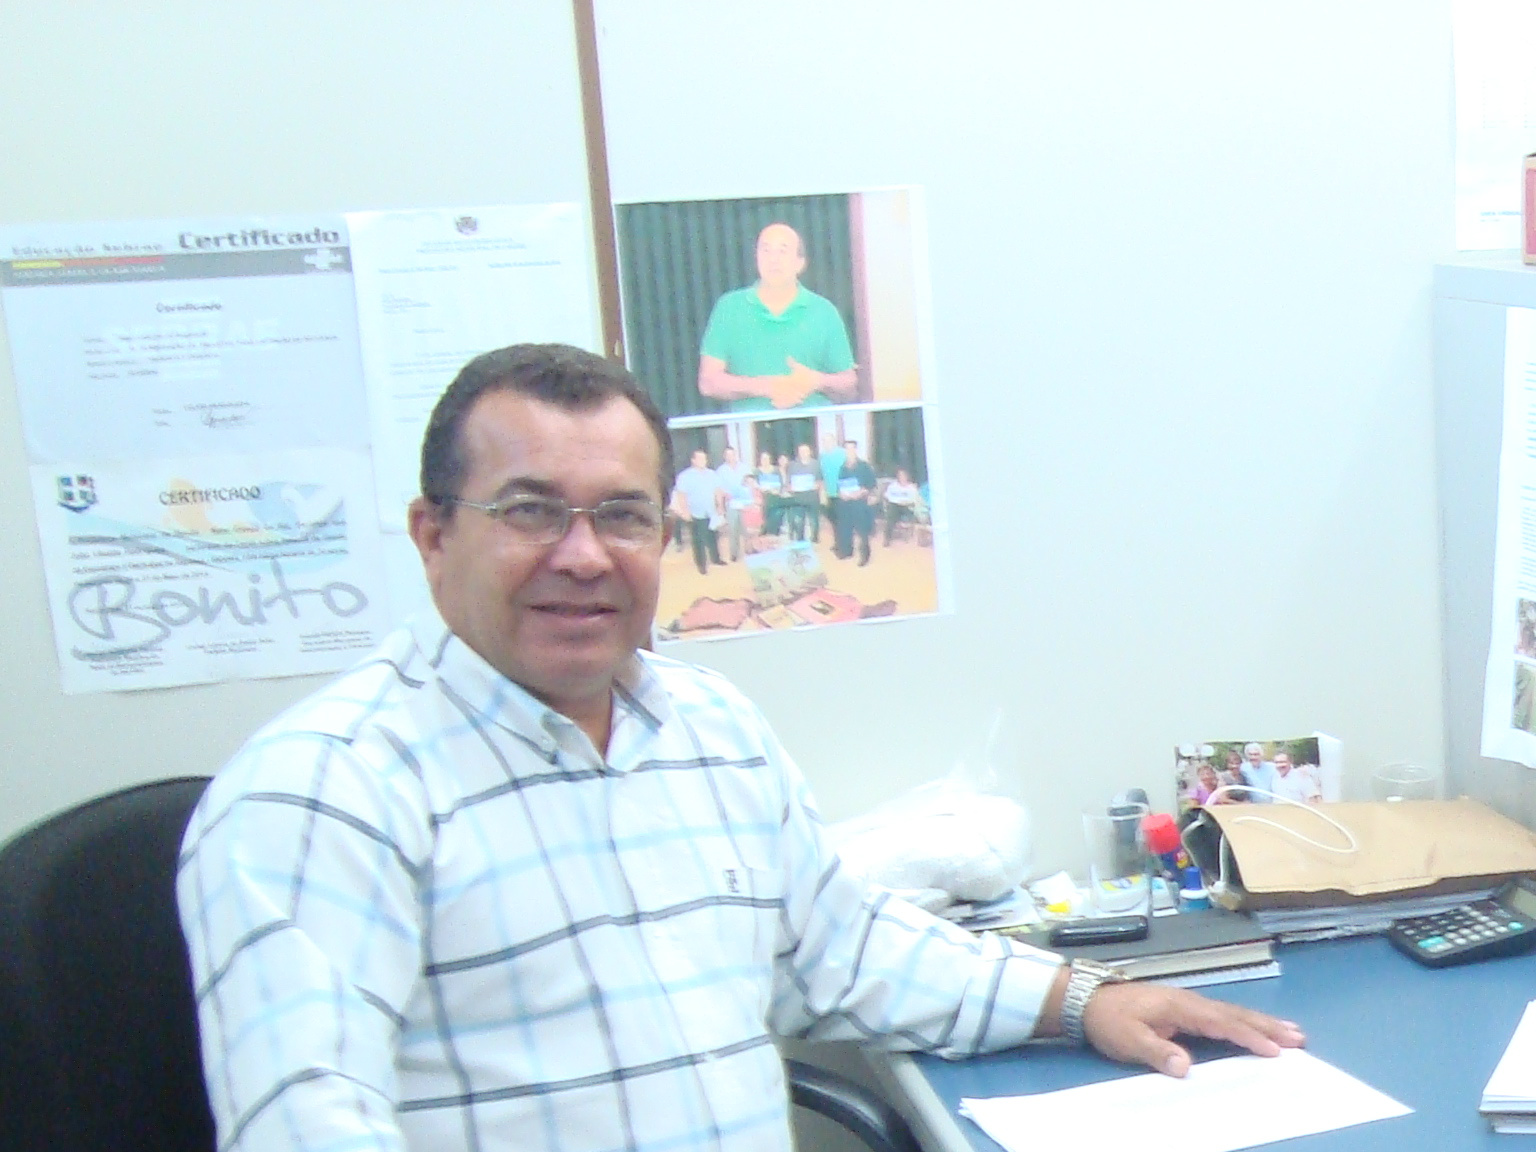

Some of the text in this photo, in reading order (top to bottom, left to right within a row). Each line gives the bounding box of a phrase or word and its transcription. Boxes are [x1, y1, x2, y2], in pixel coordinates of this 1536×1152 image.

[178, 226, 341, 250] Certificado
[158, 484, 262, 506] CERTIFICADO
[66, 557, 369, 662] Bonito
